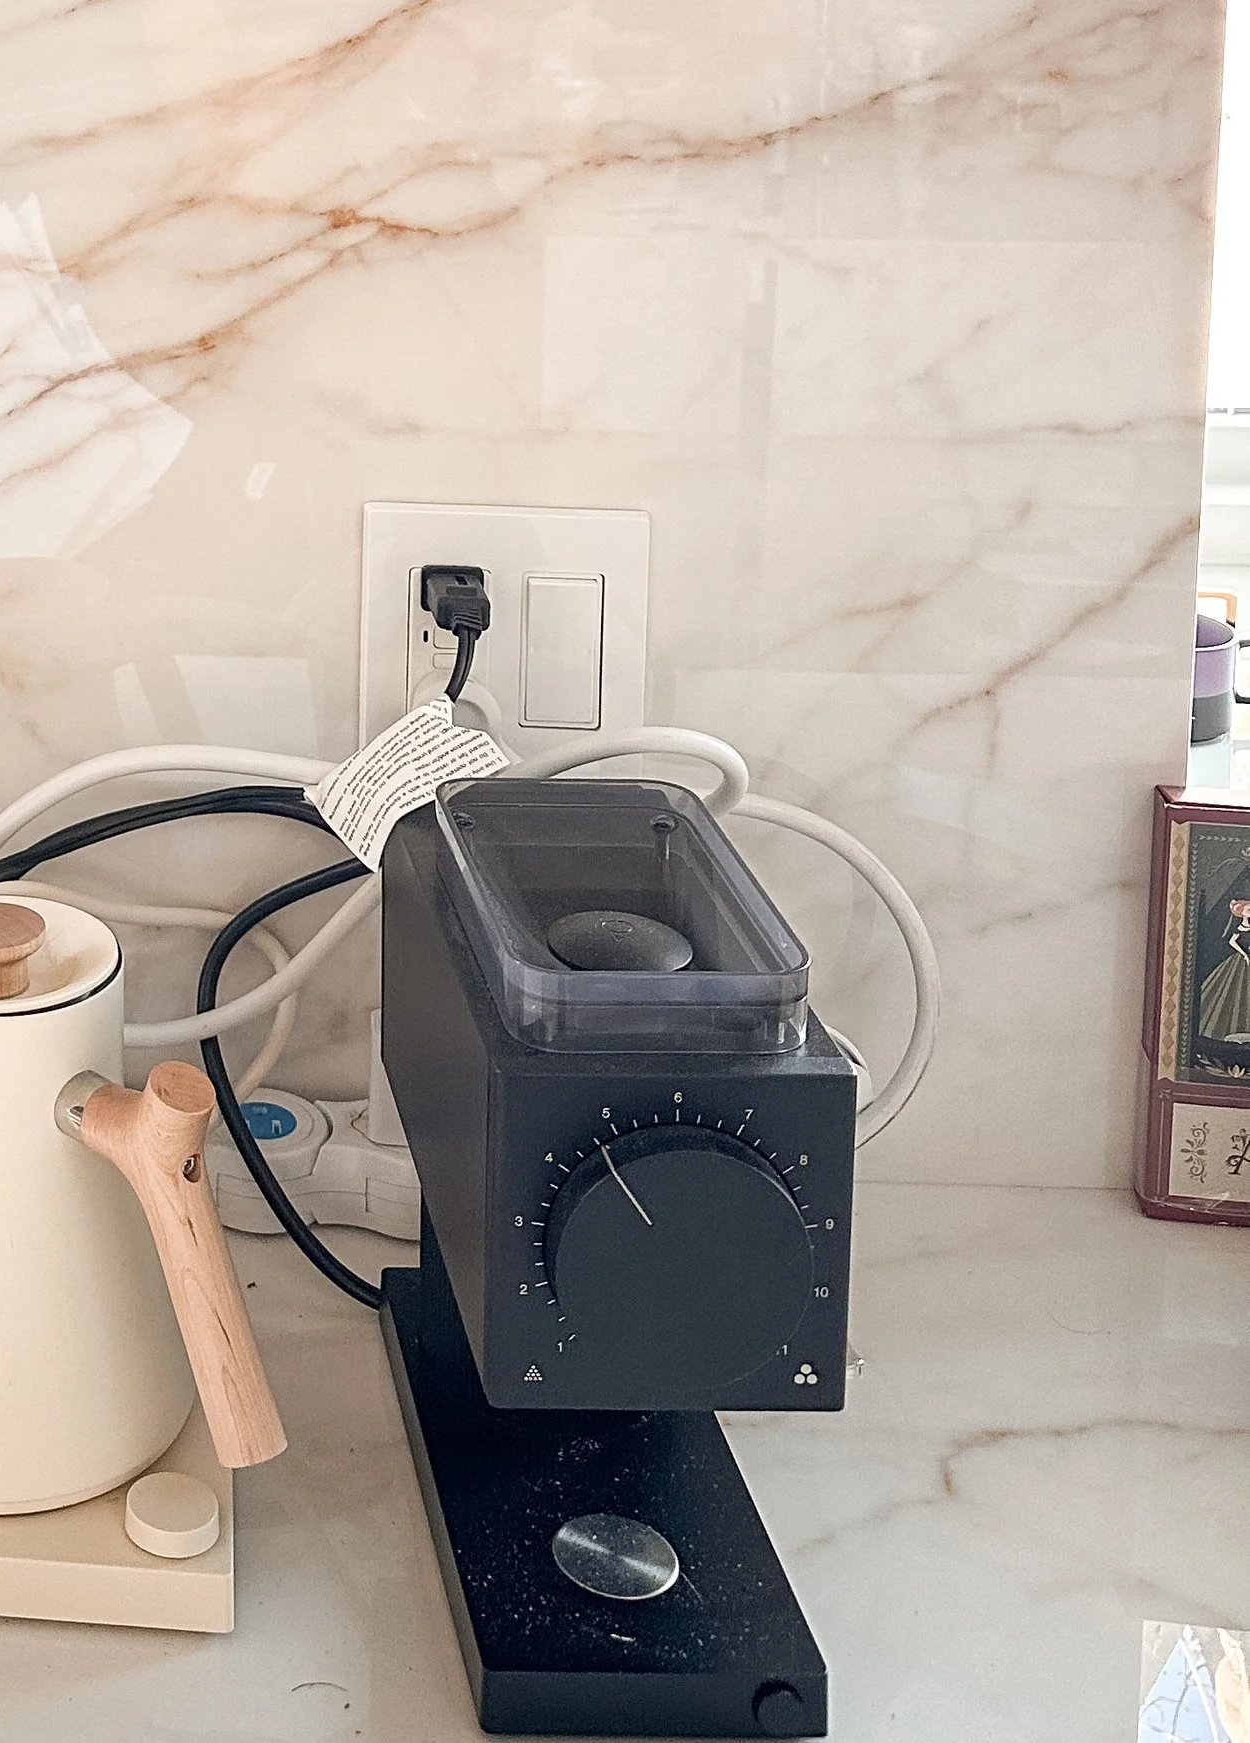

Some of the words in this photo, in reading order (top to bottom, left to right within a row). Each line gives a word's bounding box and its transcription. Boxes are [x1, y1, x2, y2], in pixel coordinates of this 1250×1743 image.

[674, 1091, 683, 1103] 6
[601, 1108, 611, 1119] 5
[744, 1109, 754, 1121] 7
[544, 1152, 554, 1163] 4
[799, 1155, 809, 1165] 8
[514, 1216, 524, 1227] 3
[825, 1219, 834, 1230] 9
[519, 1284, 529, 1295] 2
[813, 1286, 829, 1298] 10
[557, 1342, 563, 1353] 1
